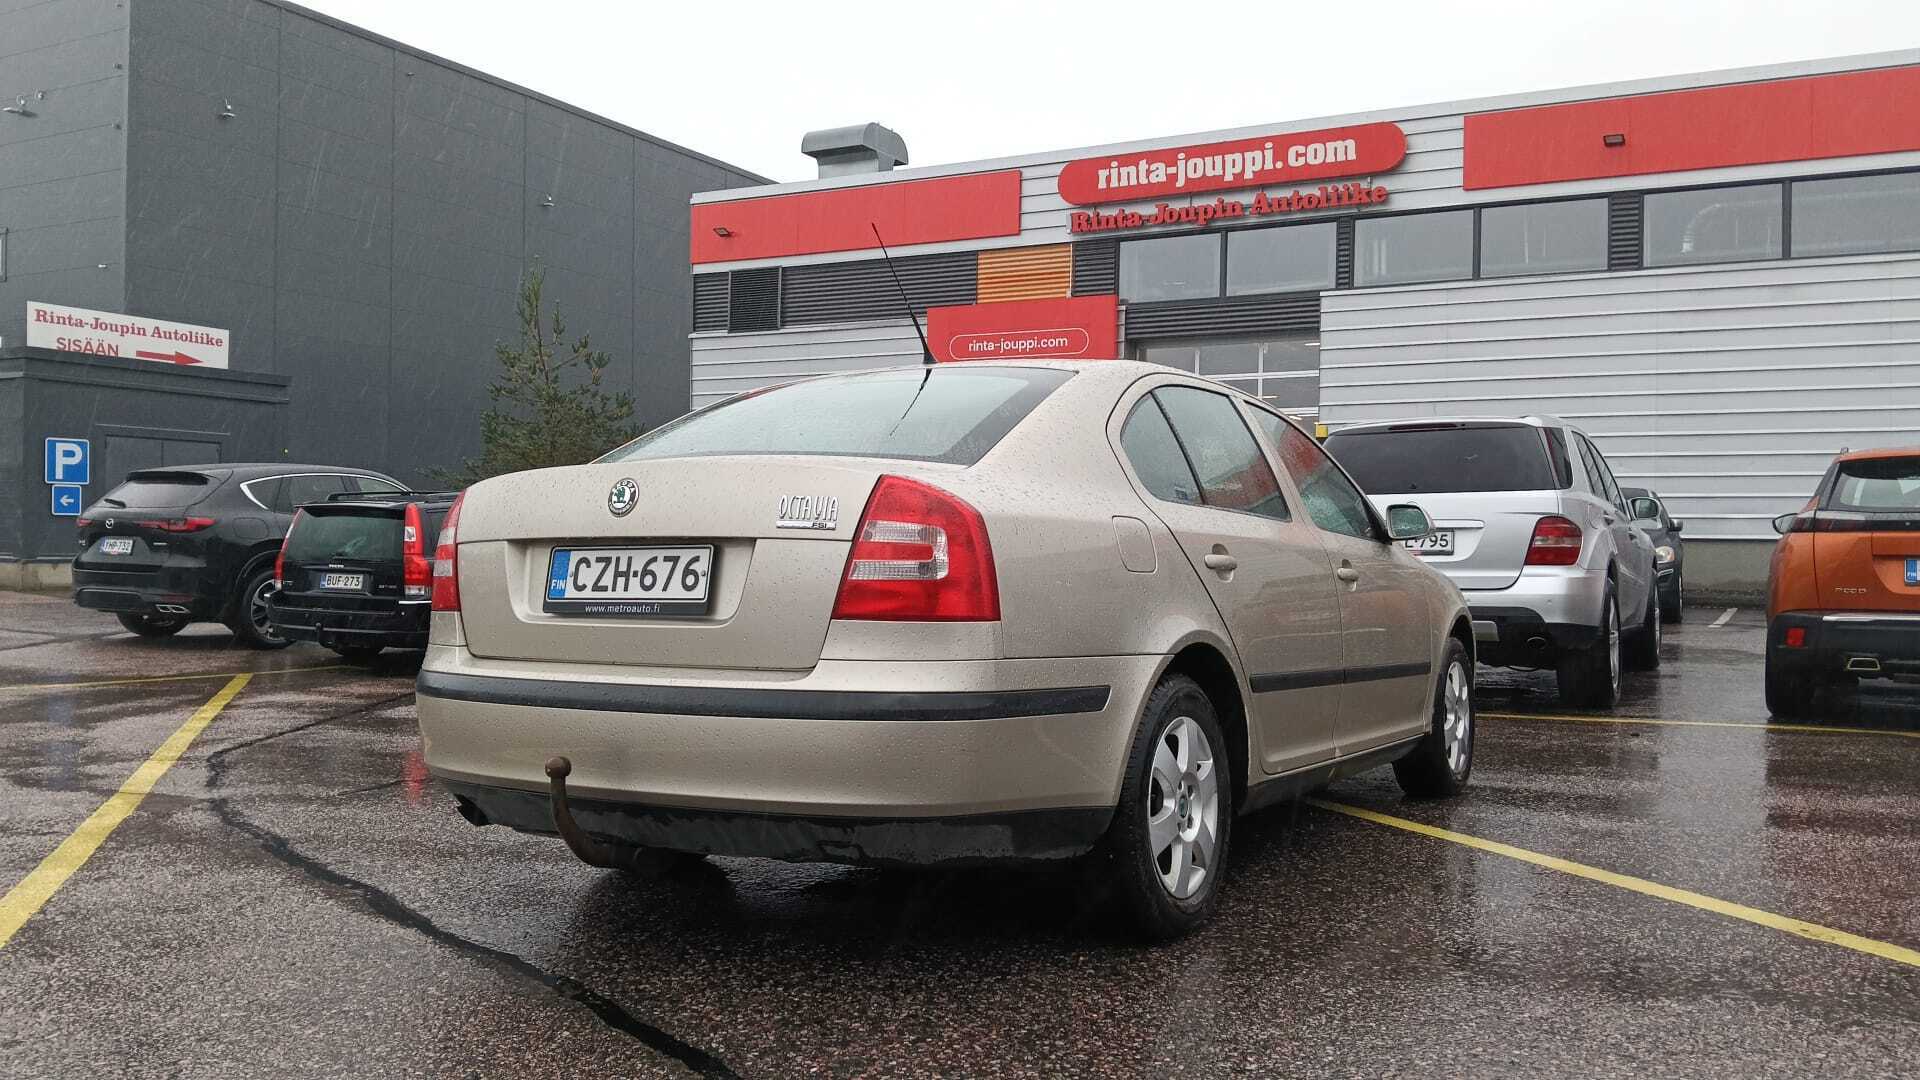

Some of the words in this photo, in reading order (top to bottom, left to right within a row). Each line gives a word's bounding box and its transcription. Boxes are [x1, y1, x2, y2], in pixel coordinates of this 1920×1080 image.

[1070, 197, 1244, 233] Rinta-Joupin
[1249, 183, 1387, 216] Autoliike
[34, 309, 147, 337] Rinta-Joupin
[151, 325, 224, 348] Autoliike
[56, 336, 119, 358] SISÄÄN
[968, 337, 1068, 353] rinta-jouppi.com
[55, 442, 83, 480] P
[778, 494, 839, 522] OCTAVIA
[551, 579, 567, 590] FIN
[572, 555, 702, 593] CZH-676
[584, 603, 661, 614] www.metroauto.fi
